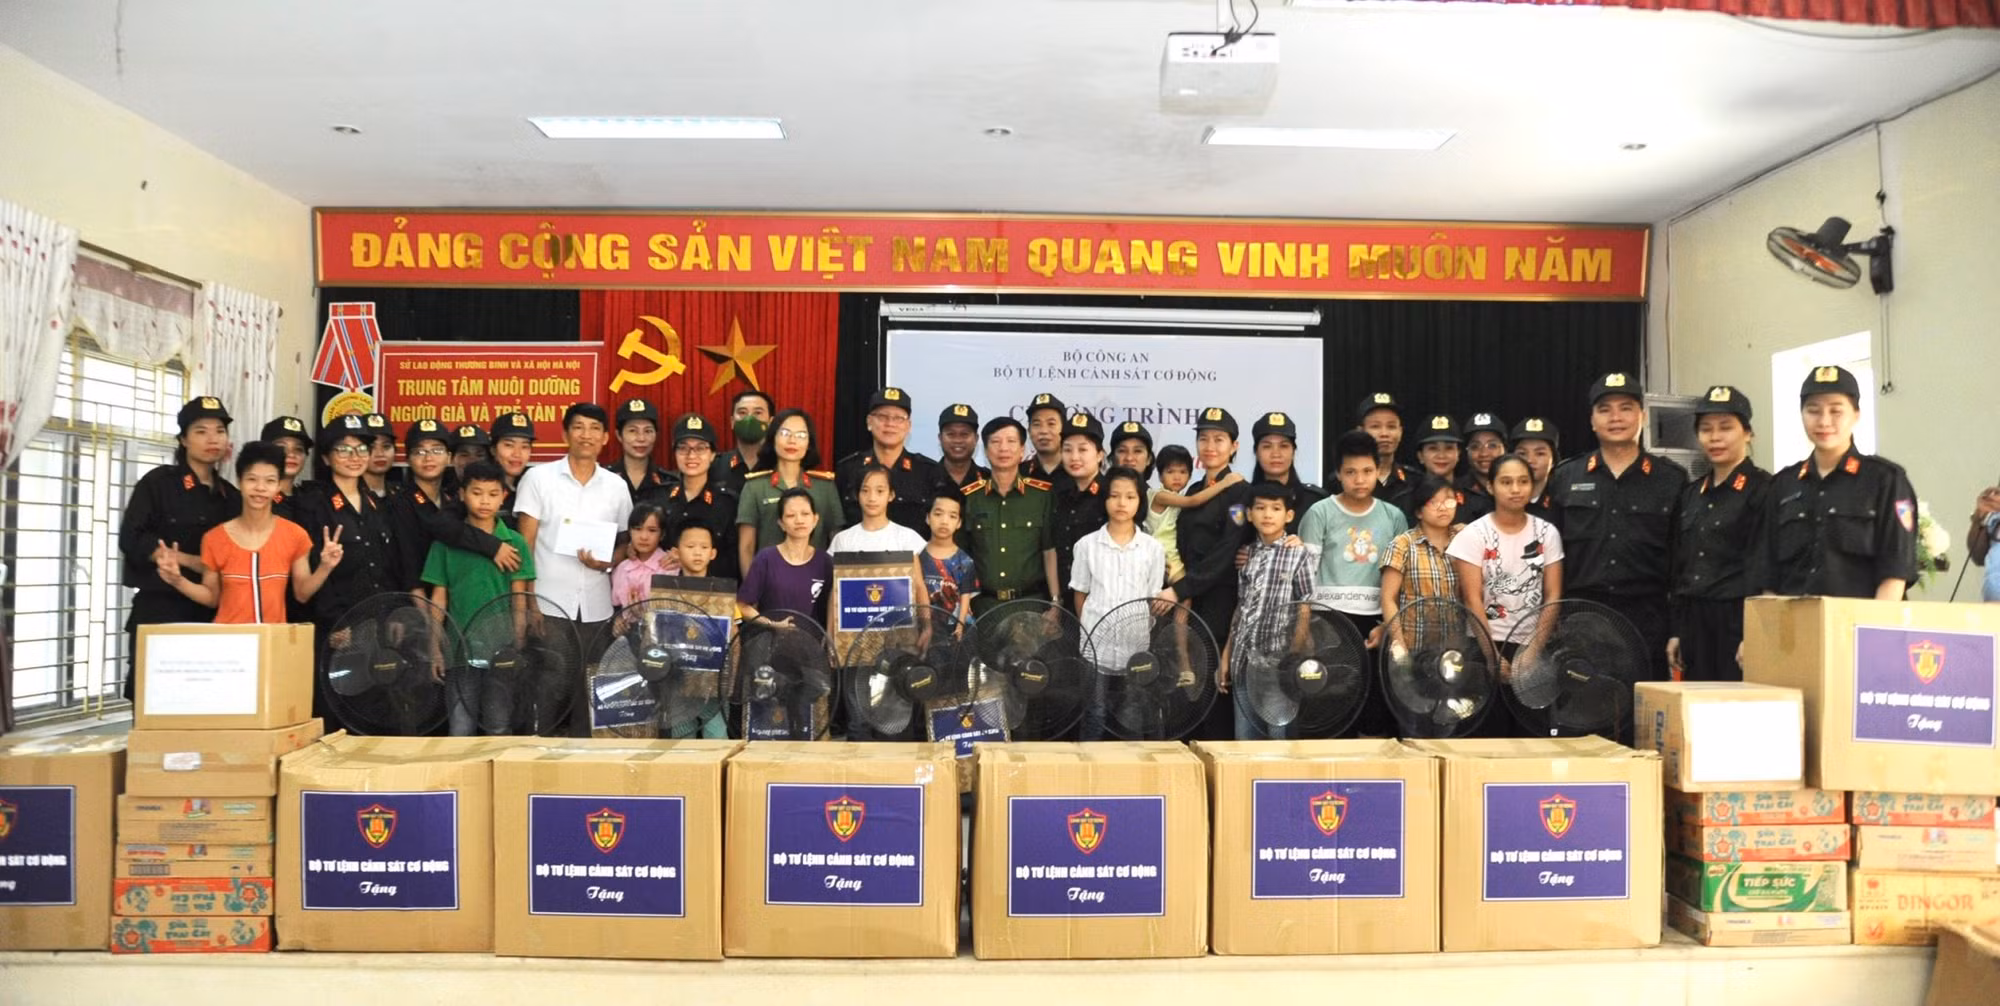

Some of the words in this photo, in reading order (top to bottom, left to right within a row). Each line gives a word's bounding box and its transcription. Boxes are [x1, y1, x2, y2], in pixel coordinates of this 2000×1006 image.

[351, 216, 484, 268] ĐẢNG
[499, 221, 630, 279] CỘNG
[647, 219, 752, 271] SẢN
[767, 226, 873, 280] VIỆT
[892, 237, 1009, 273] NAM
[1027, 237, 1198, 278] QUANG
[1217, 242, 1329, 279] VINH
[1348, 232, 1487, 281] MUÔN
[1504, 236, 1613, 283] NĂM
[1063, 350, 1082, 364] BỘ
[1086, 349, 1126, 363] CÔNG
[1129, 352, 1149, 362] AN
[413, 361, 428, 370] LAO
[489, 361, 509, 369] BINH
[993, 367, 1013, 380] BỘ
[1015, 367, 1036, 378] TƯ
[1038, 366, 1076, 381] LỆNH
[1081, 366, 1120, 380] CẢNH
[1124, 368, 1150, 380] SÁT
[1153, 370, 1176, 381] CƠ
[1177, 368, 1217, 383] ĐỘNG
[397, 379, 447, 396] TRUNG
[451, 376, 484, 396] TÂM
[488, 376, 524, 396] NUÔI
[529, 375, 581, 396] DƯỠNG
[390, 402, 437, 423] NGƯỜI
[440, 402, 470, 422] GIÀ
[470, 402, 490, 422] VÀ
[526, 402, 556, 422] TÀN
[1123, 402, 1200, 424] TRÌNH
[824, 875, 862, 891] Tặng
[1309, 868, 1346, 884] Tặng
[359, 881, 397, 896] Tặng
[586, 886, 624, 902] Tặng
[1067, 887, 1105, 903] Tặng
